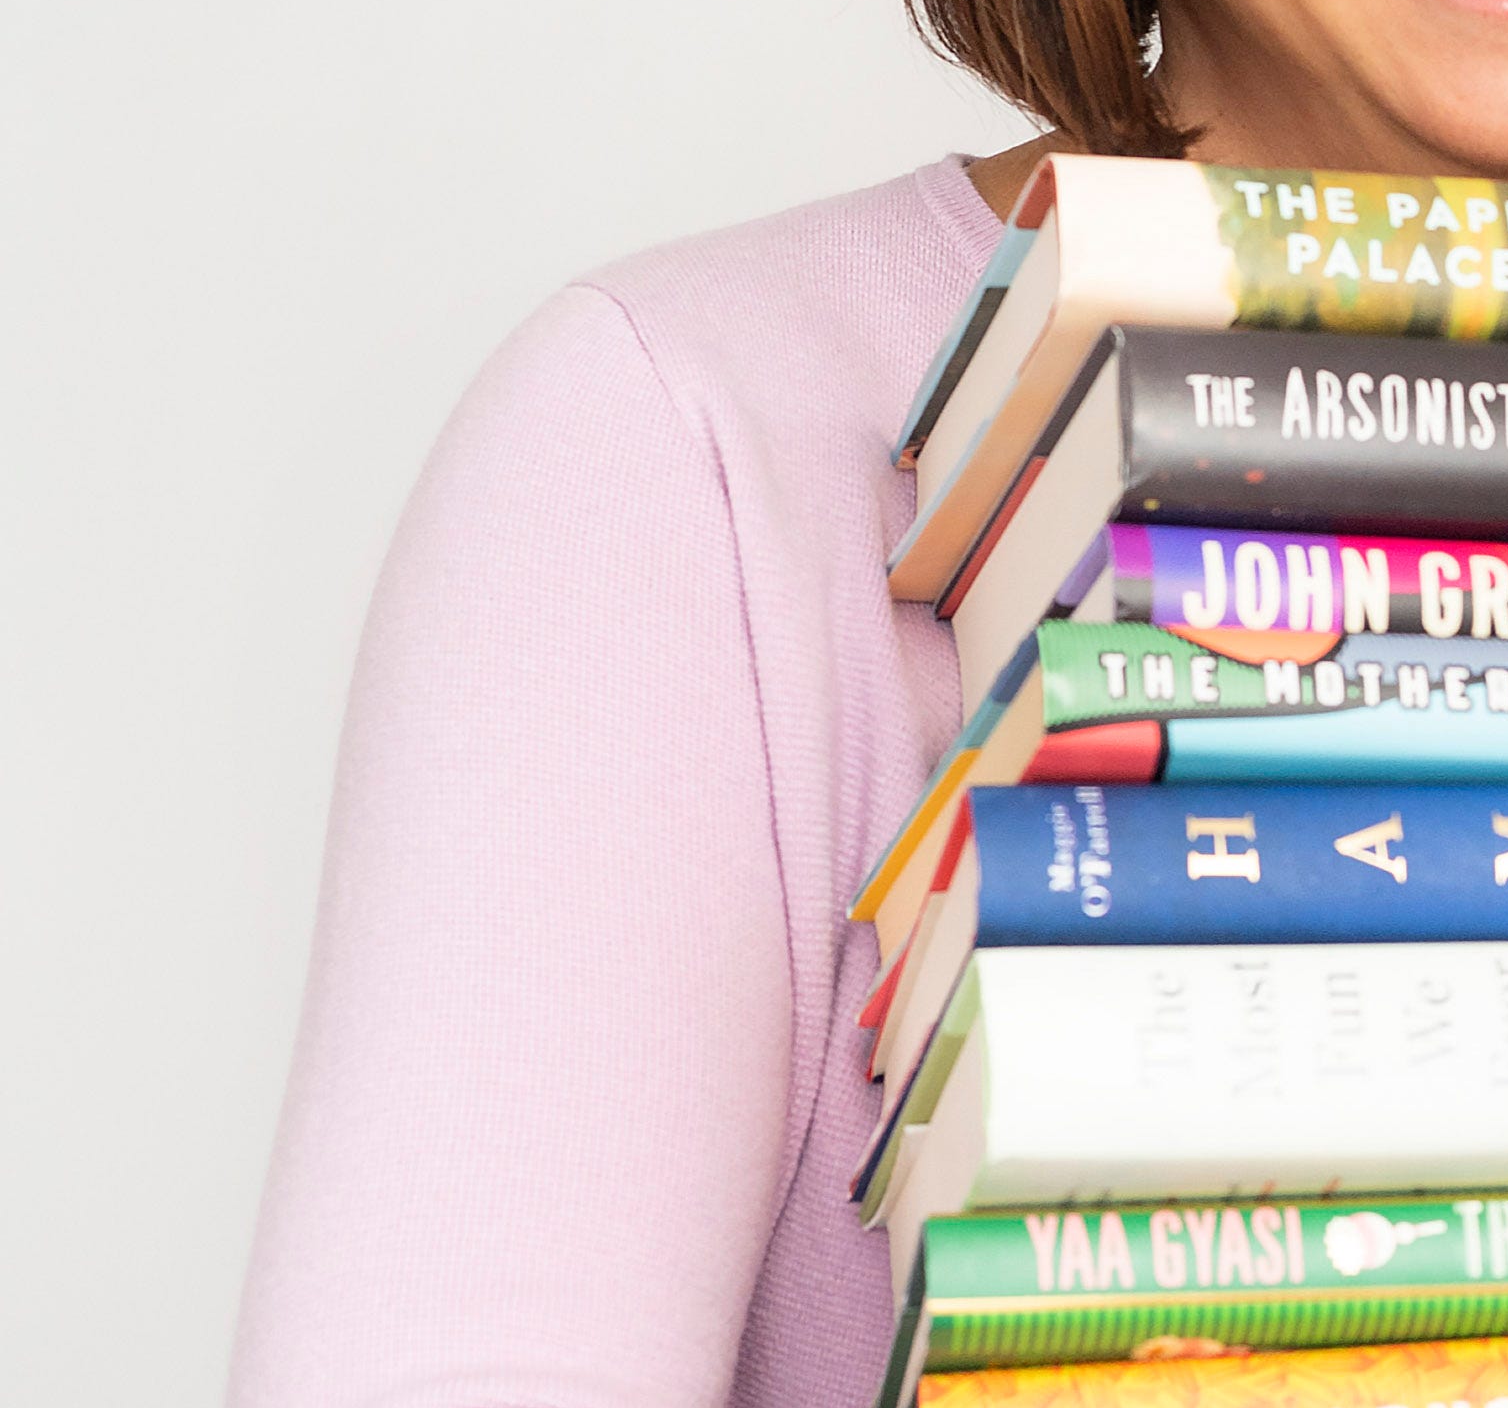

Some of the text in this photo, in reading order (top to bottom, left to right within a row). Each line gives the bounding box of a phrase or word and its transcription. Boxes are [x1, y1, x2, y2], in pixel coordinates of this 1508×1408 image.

[1234, 179, 1359, 225] THE
[1185, 373, 1256, 429] THE
[1182, 539, 1390, 634] JOHN
[1100, 651, 1221, 703] THE
[1134, 967, 1194, 1089] The
[1230, 955, 1287, 1101] Most
[1316, 967, 1370, 1082] Fun
[1404, 973, 1456, 1069] We
[1025, 1205, 1303, 1293] YAA GYASI
